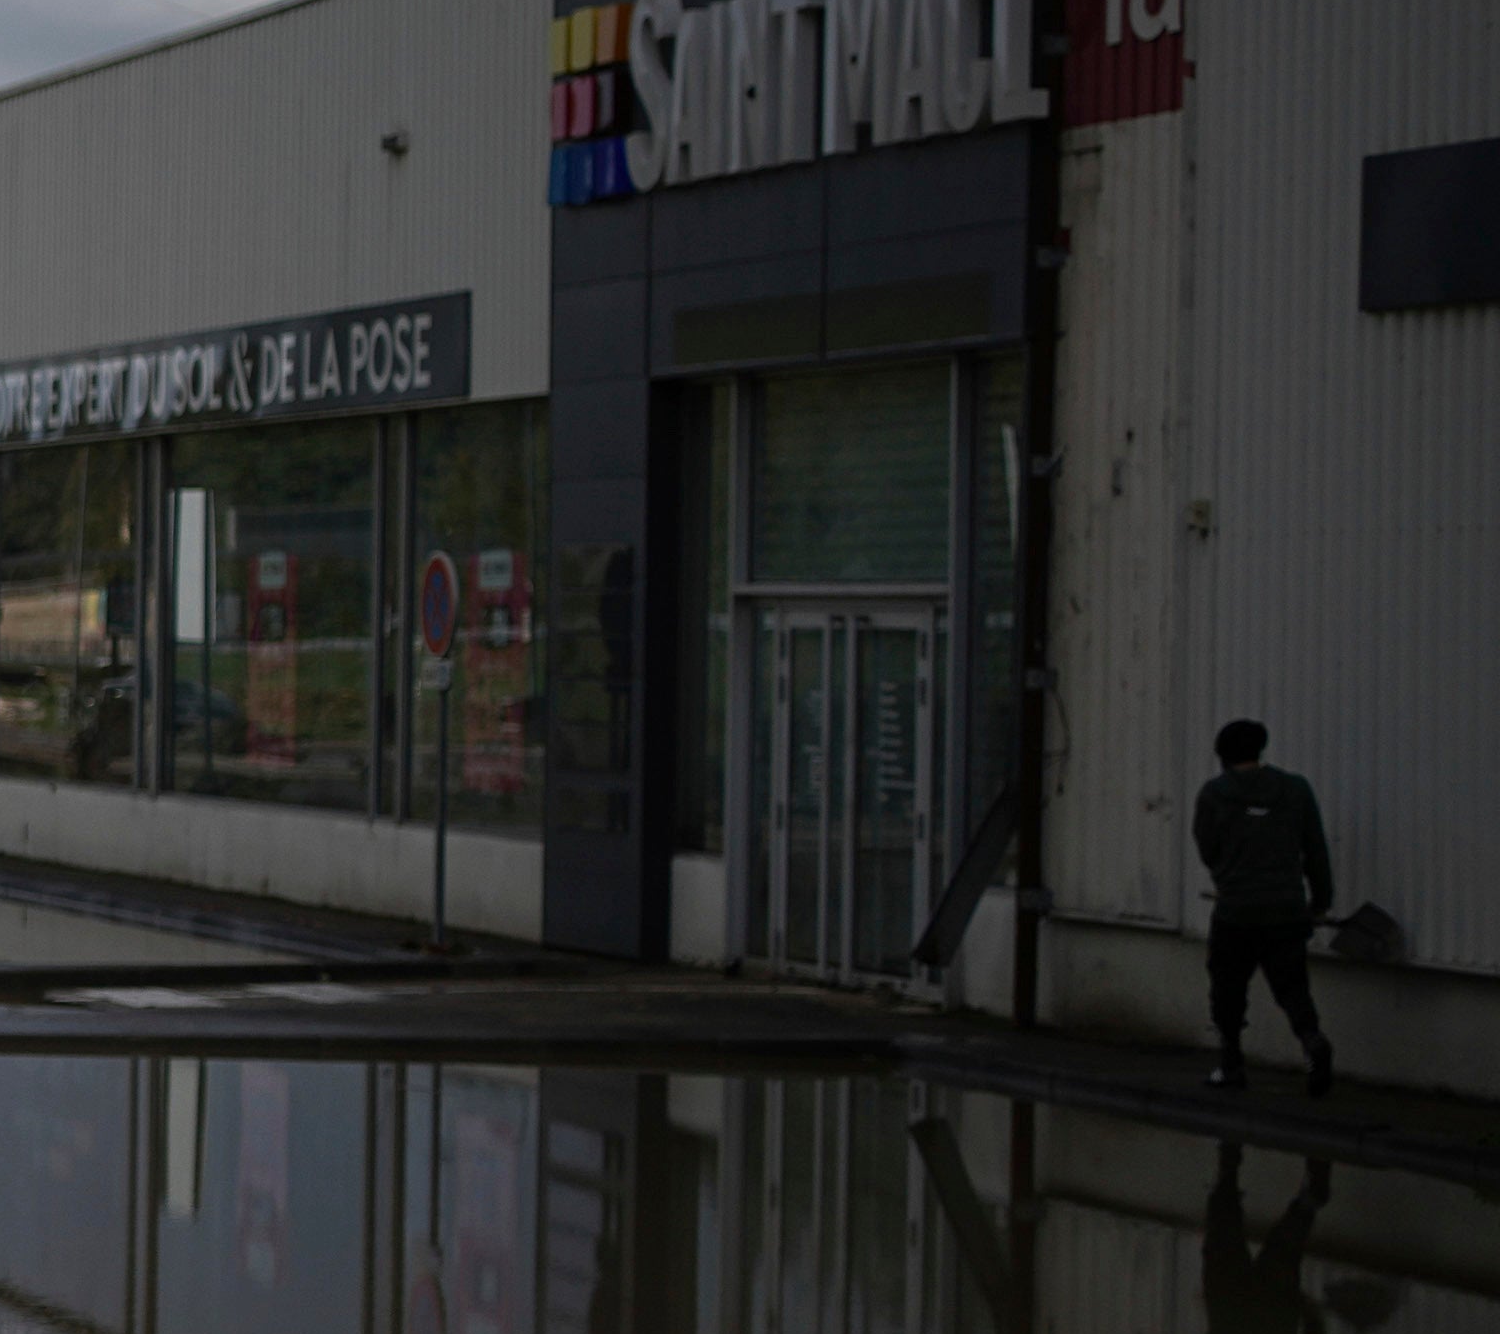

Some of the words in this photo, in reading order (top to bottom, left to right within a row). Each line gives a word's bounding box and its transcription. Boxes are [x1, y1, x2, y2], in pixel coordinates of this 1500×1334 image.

[47, 358, 126, 428] EXPERT
[129, 353, 167, 418] DU
[171, 344, 222, 416] SOL
[227, 331, 253, 412] &
[260, 331, 296, 406] DE
[303, 327, 342, 400] LA
[349, 313, 433, 396] POSE
